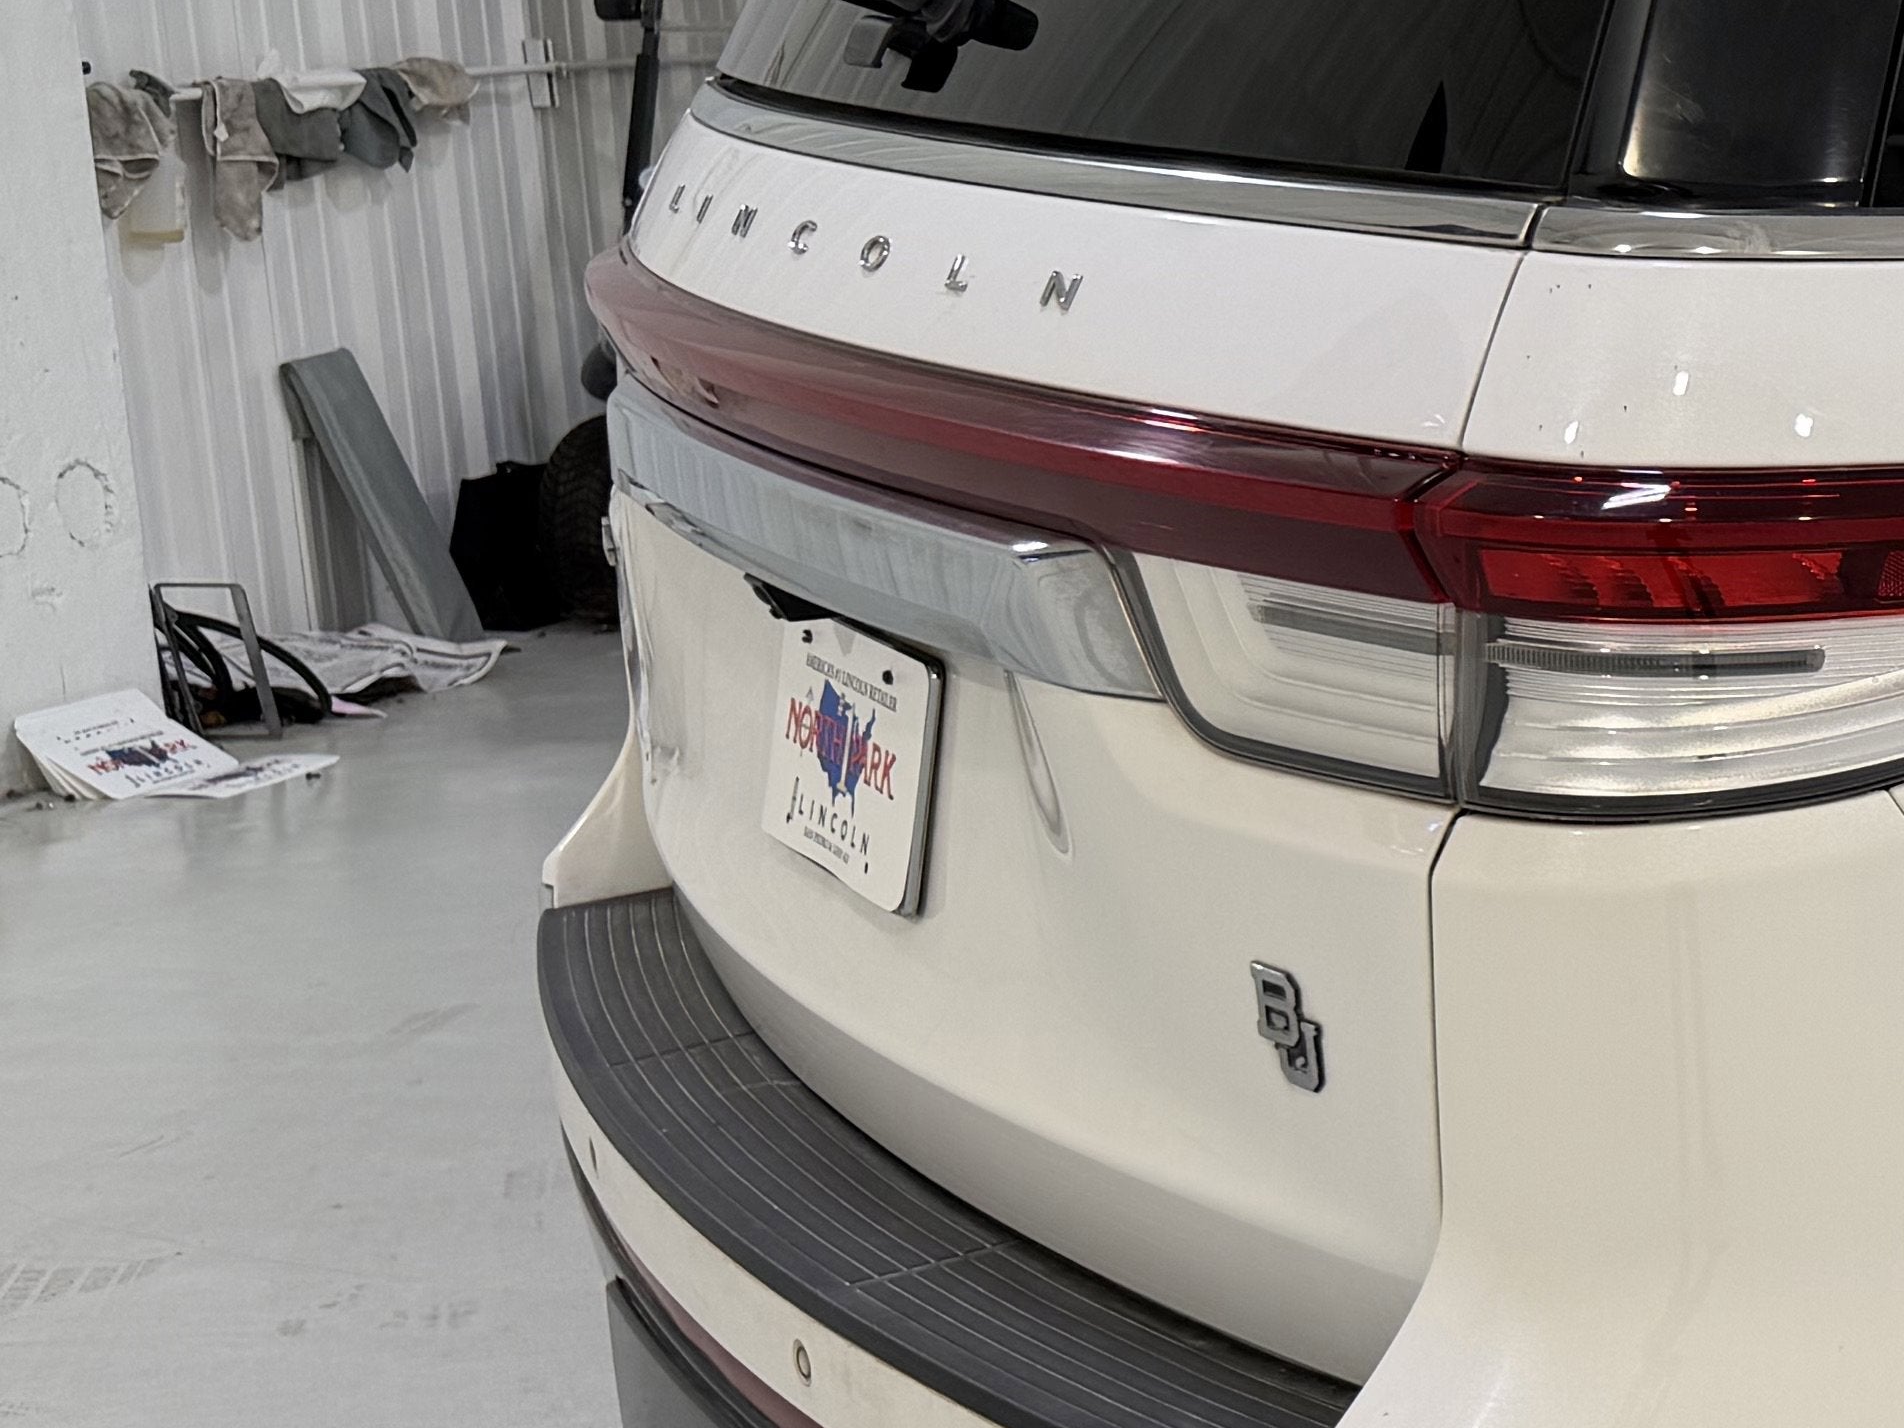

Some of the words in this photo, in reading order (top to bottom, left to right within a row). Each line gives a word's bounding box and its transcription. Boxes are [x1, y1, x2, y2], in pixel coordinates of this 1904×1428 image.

[669, 183, 1083, 311] LINCOLN
[784, 696, 848, 768] NORTH
[849, 732, 897, 801] PARK
[798, 792, 870, 856] LINCOLN
